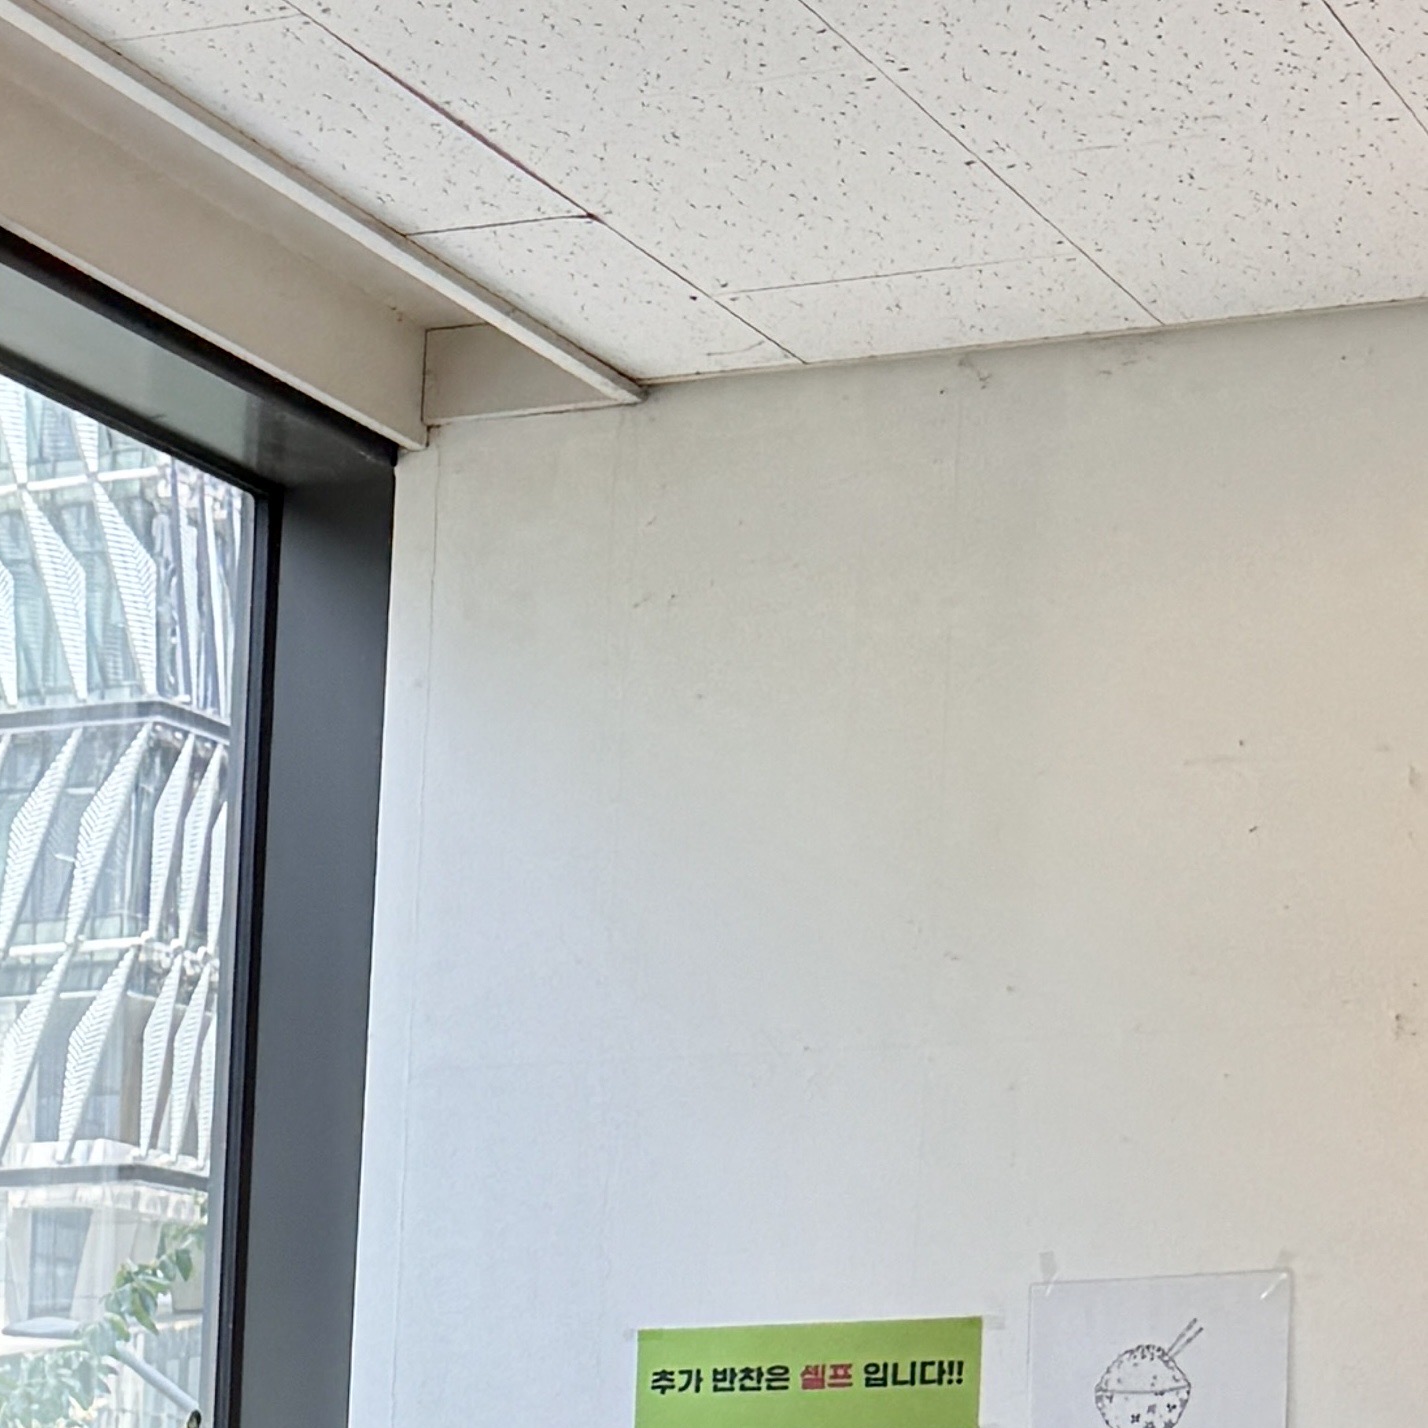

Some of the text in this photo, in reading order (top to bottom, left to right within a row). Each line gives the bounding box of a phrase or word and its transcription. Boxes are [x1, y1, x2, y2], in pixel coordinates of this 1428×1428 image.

[650, 1359, 965, 1395] 추가 반찬은 셀프 입니다!!
